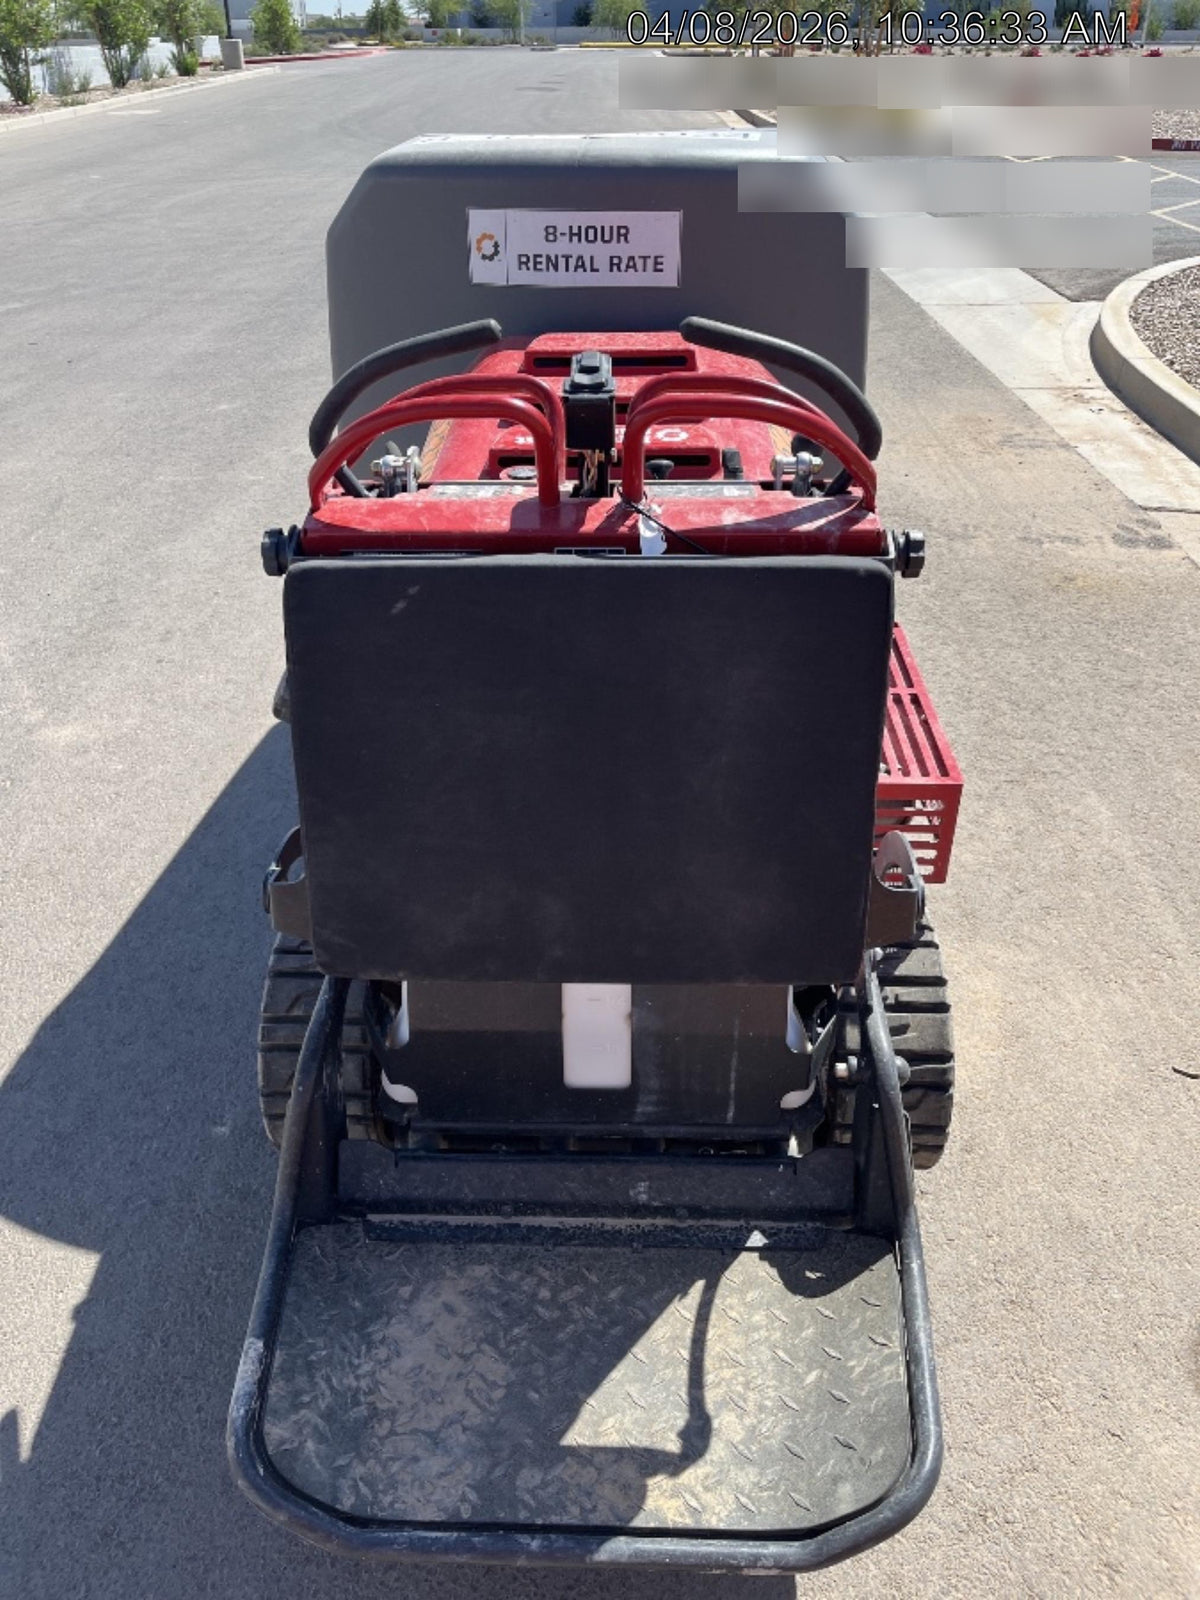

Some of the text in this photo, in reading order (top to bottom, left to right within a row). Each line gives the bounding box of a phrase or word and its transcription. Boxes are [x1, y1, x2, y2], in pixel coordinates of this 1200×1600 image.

[543, 225, 630, 243] 8-HOUR
[517, 253, 665, 272] RENTAL RATE
